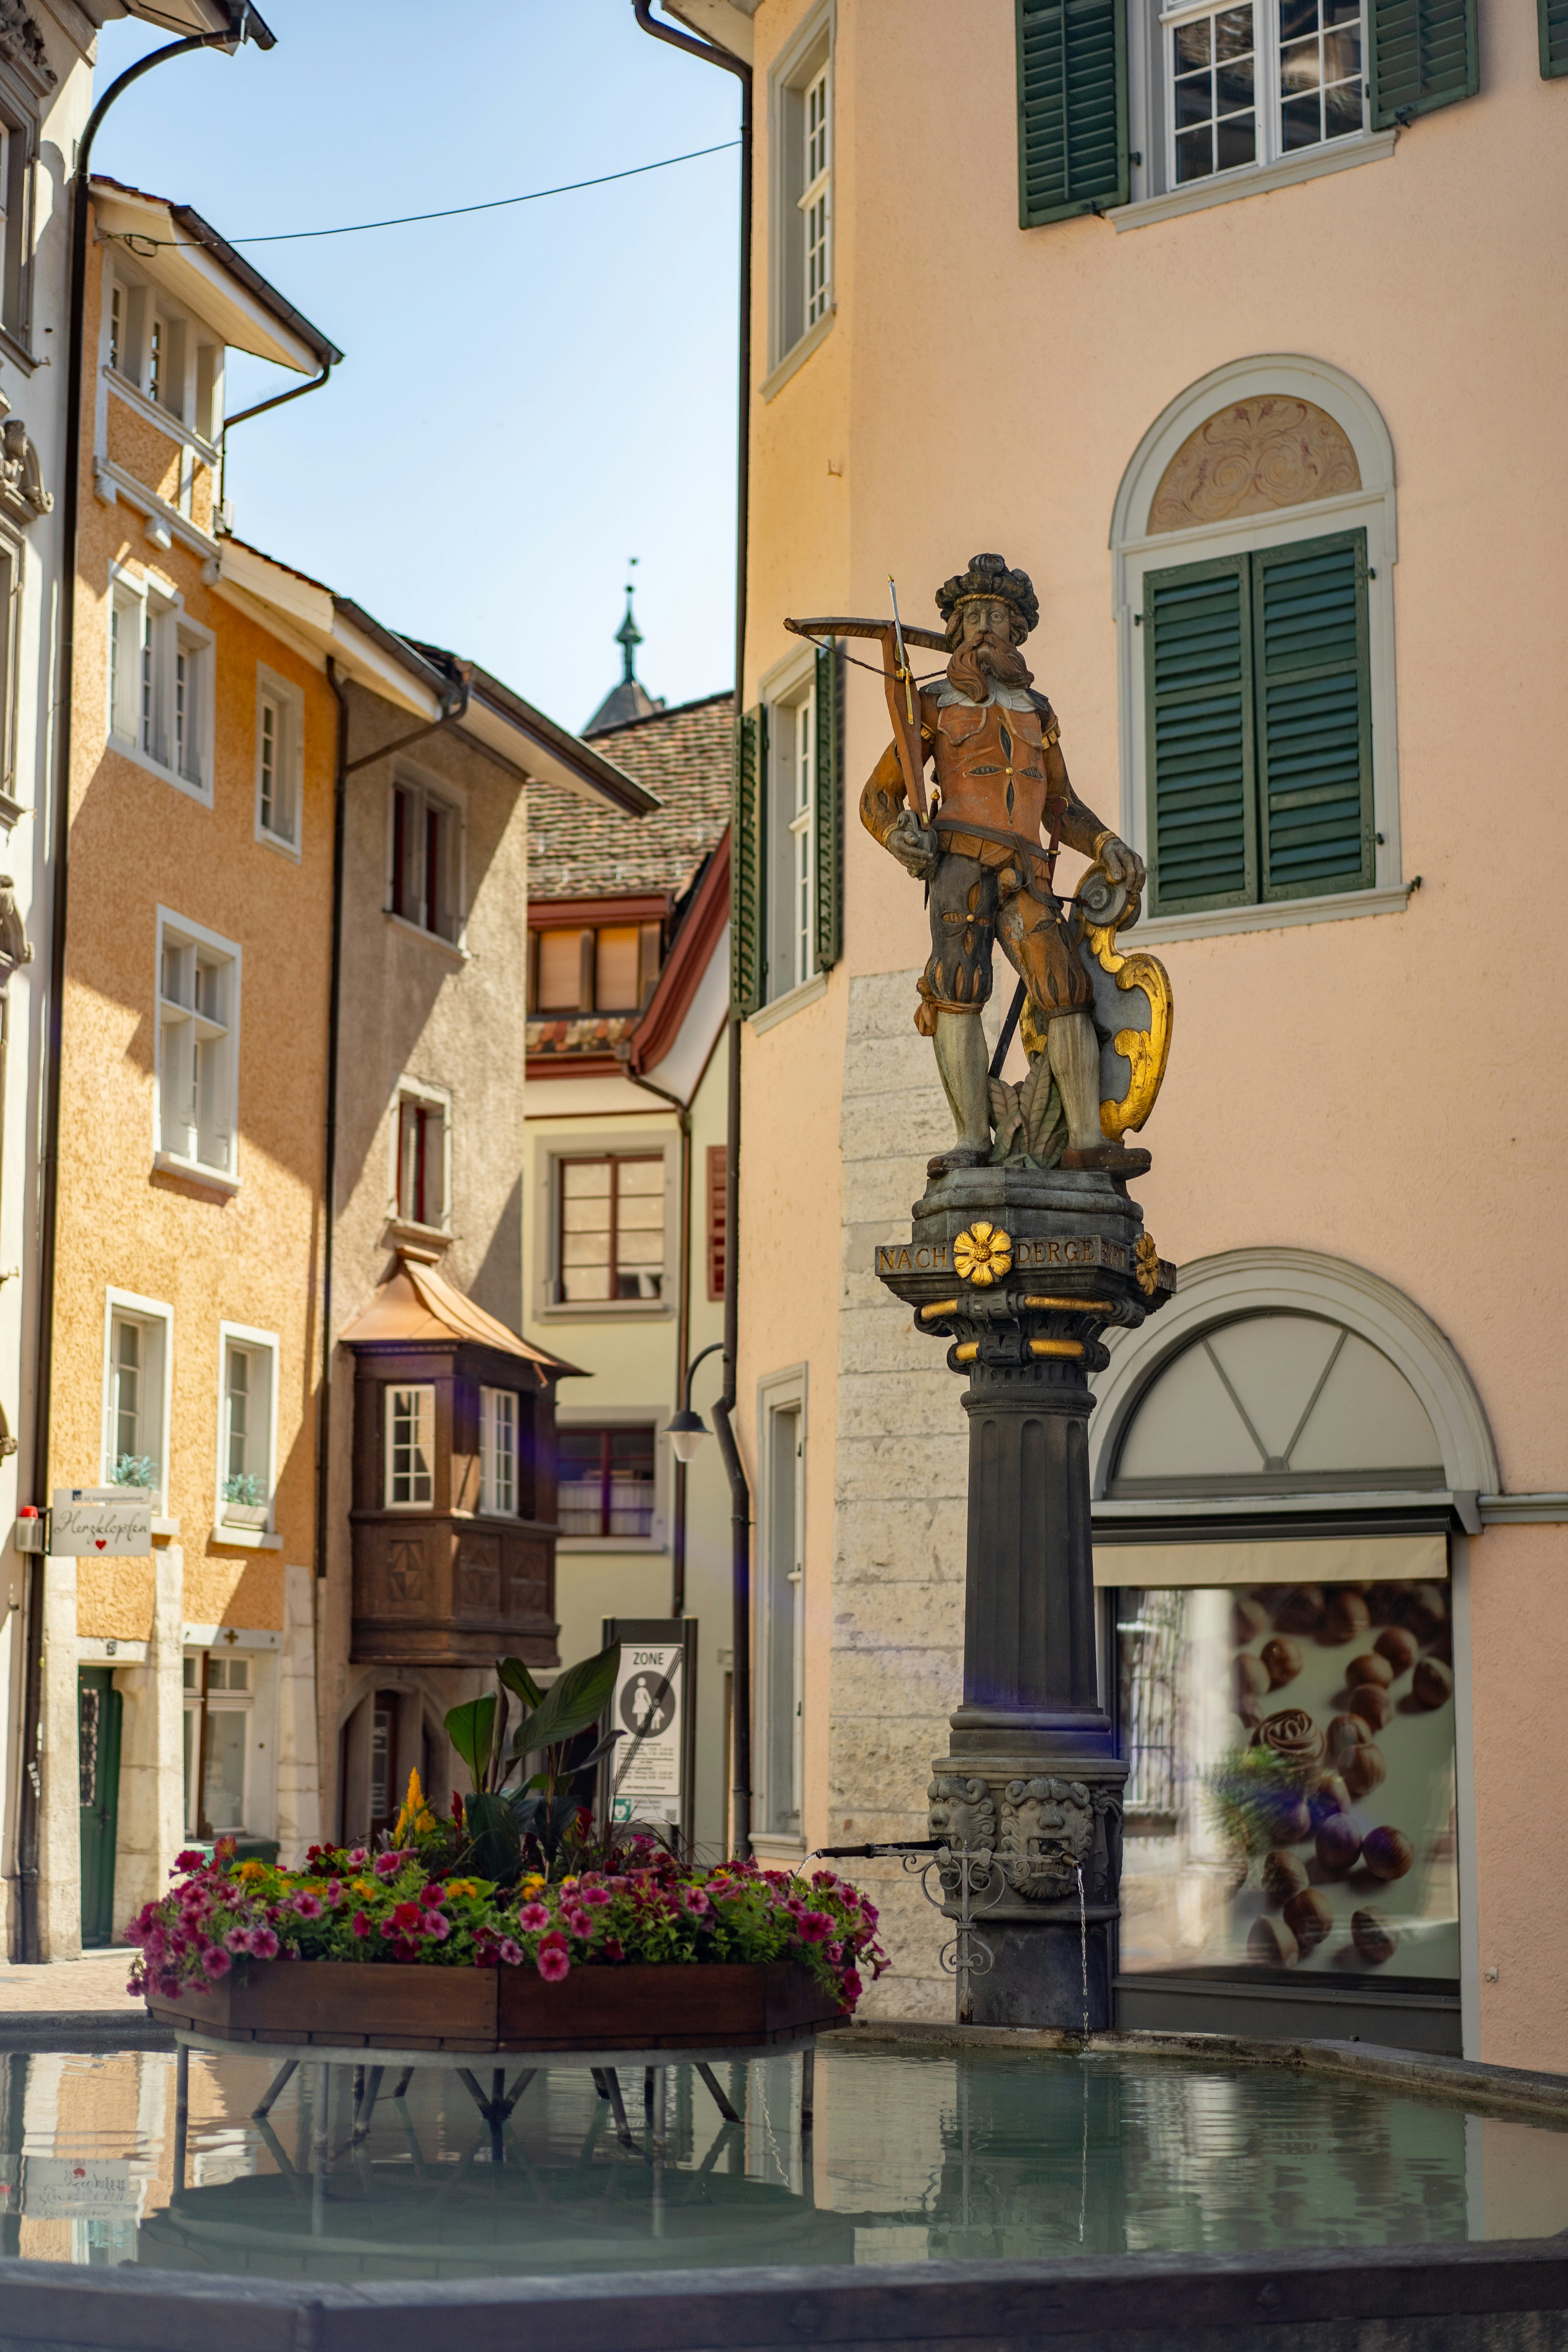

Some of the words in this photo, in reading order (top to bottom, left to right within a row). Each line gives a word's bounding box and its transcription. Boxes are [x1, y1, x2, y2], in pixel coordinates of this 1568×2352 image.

[879, 1247, 947, 1270] NACH
[54, 1510, 147, 1546] Herzklopfen
[633, 1652, 664, 1665] ZONE
